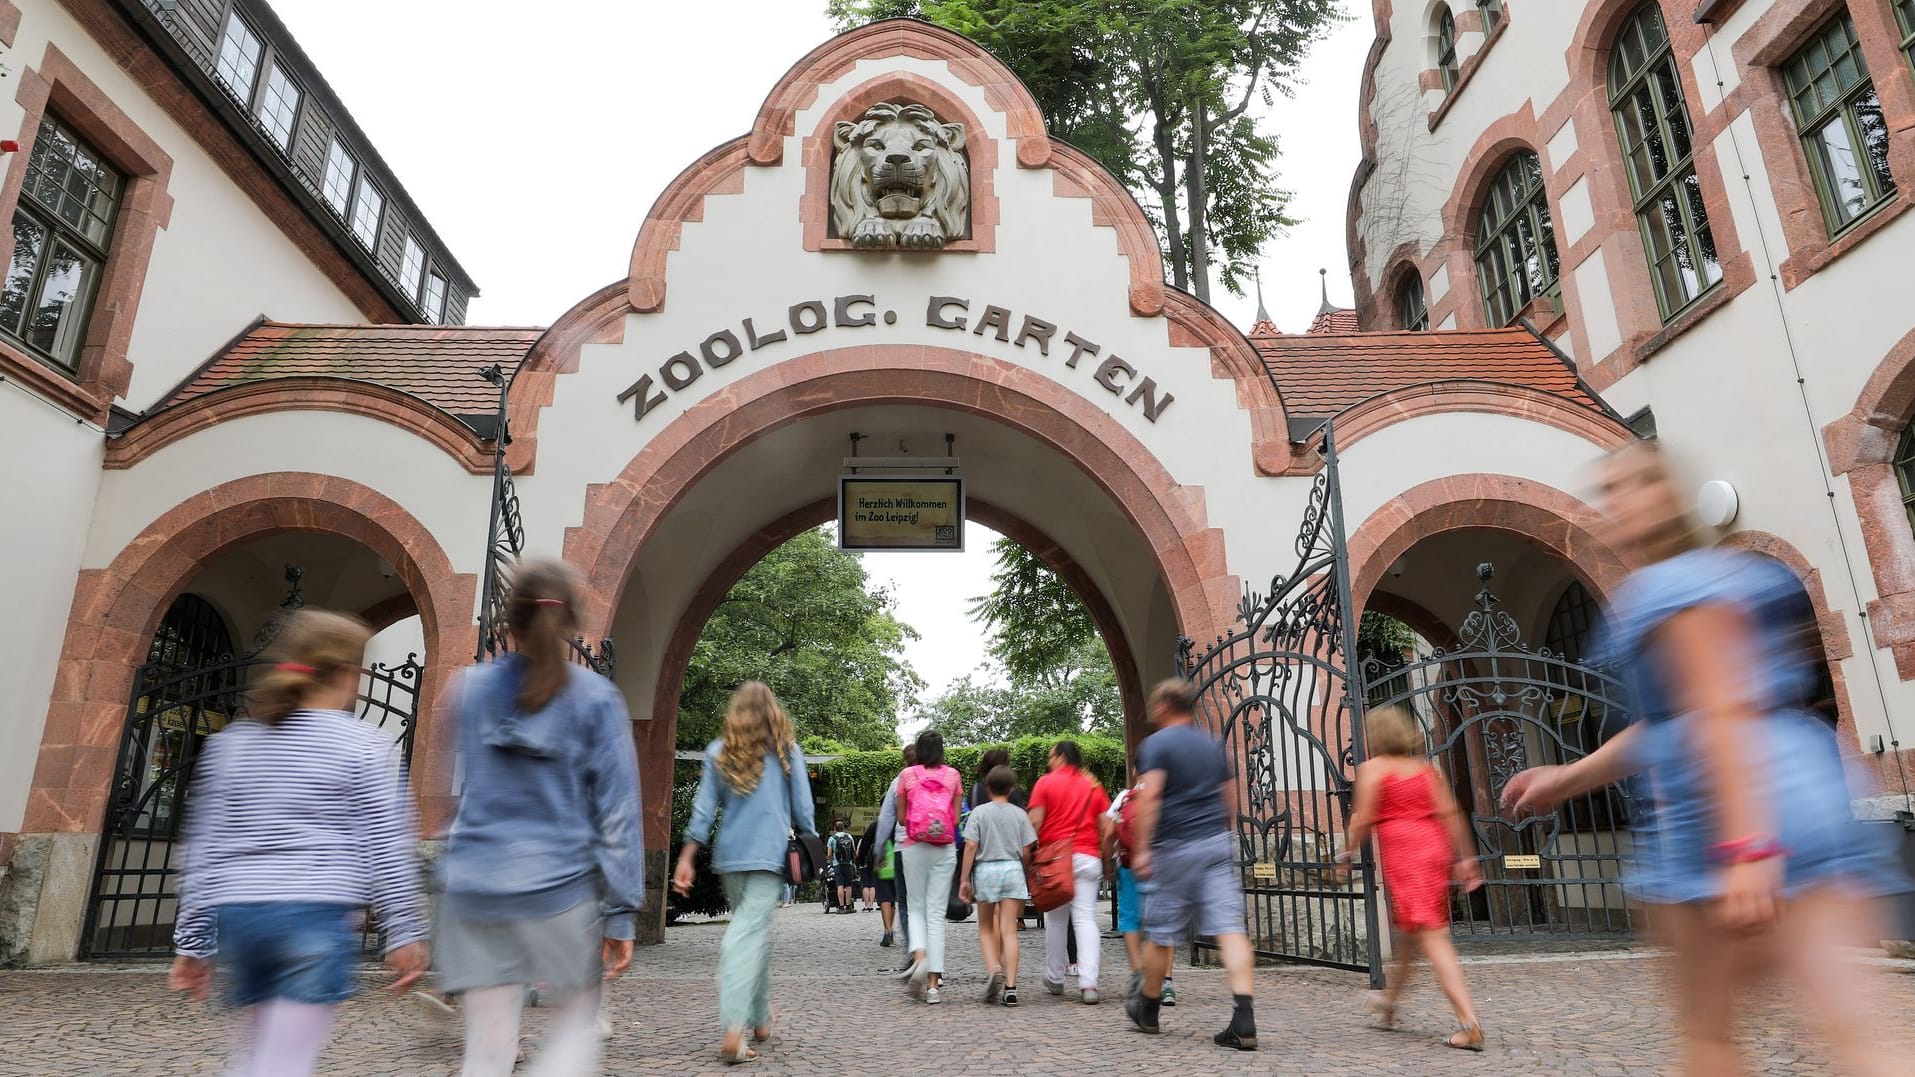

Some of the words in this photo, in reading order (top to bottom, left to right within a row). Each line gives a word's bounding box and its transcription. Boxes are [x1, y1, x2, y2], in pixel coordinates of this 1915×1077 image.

[617, 294, 898, 421] ZOOLOG.
[926, 295, 1175, 424] GARTEN
[859, 498, 893, 509] Herzlich
[895, 498, 947, 509] Willkommen
[855, 512, 866, 521] im
[868, 512, 884, 521] Zoo
[886, 512, 919, 525] Leipzig!
